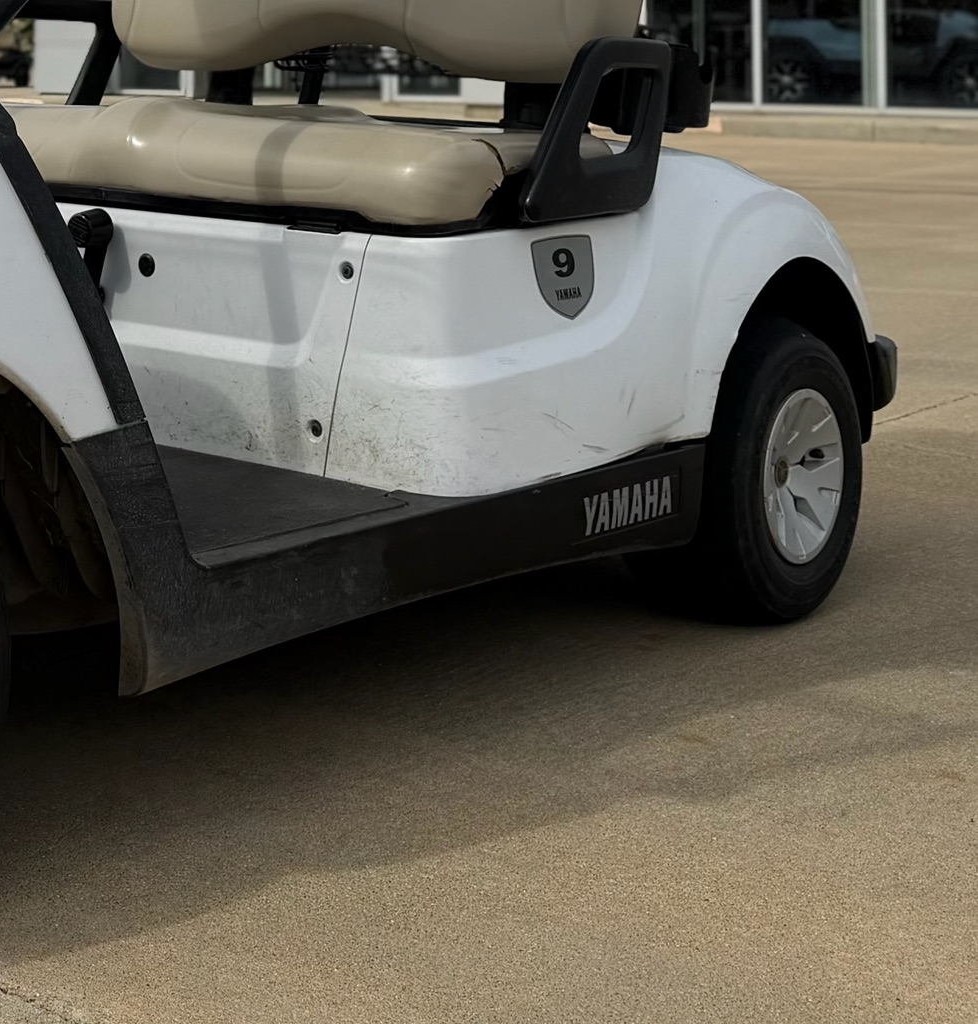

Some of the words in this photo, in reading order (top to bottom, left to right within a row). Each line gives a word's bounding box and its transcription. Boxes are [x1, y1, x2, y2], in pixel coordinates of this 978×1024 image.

[552, 248, 575, 278] 9
[555, 286, 582, 301] YAMAHA
[583, 475, 672, 536] YAMAHA
